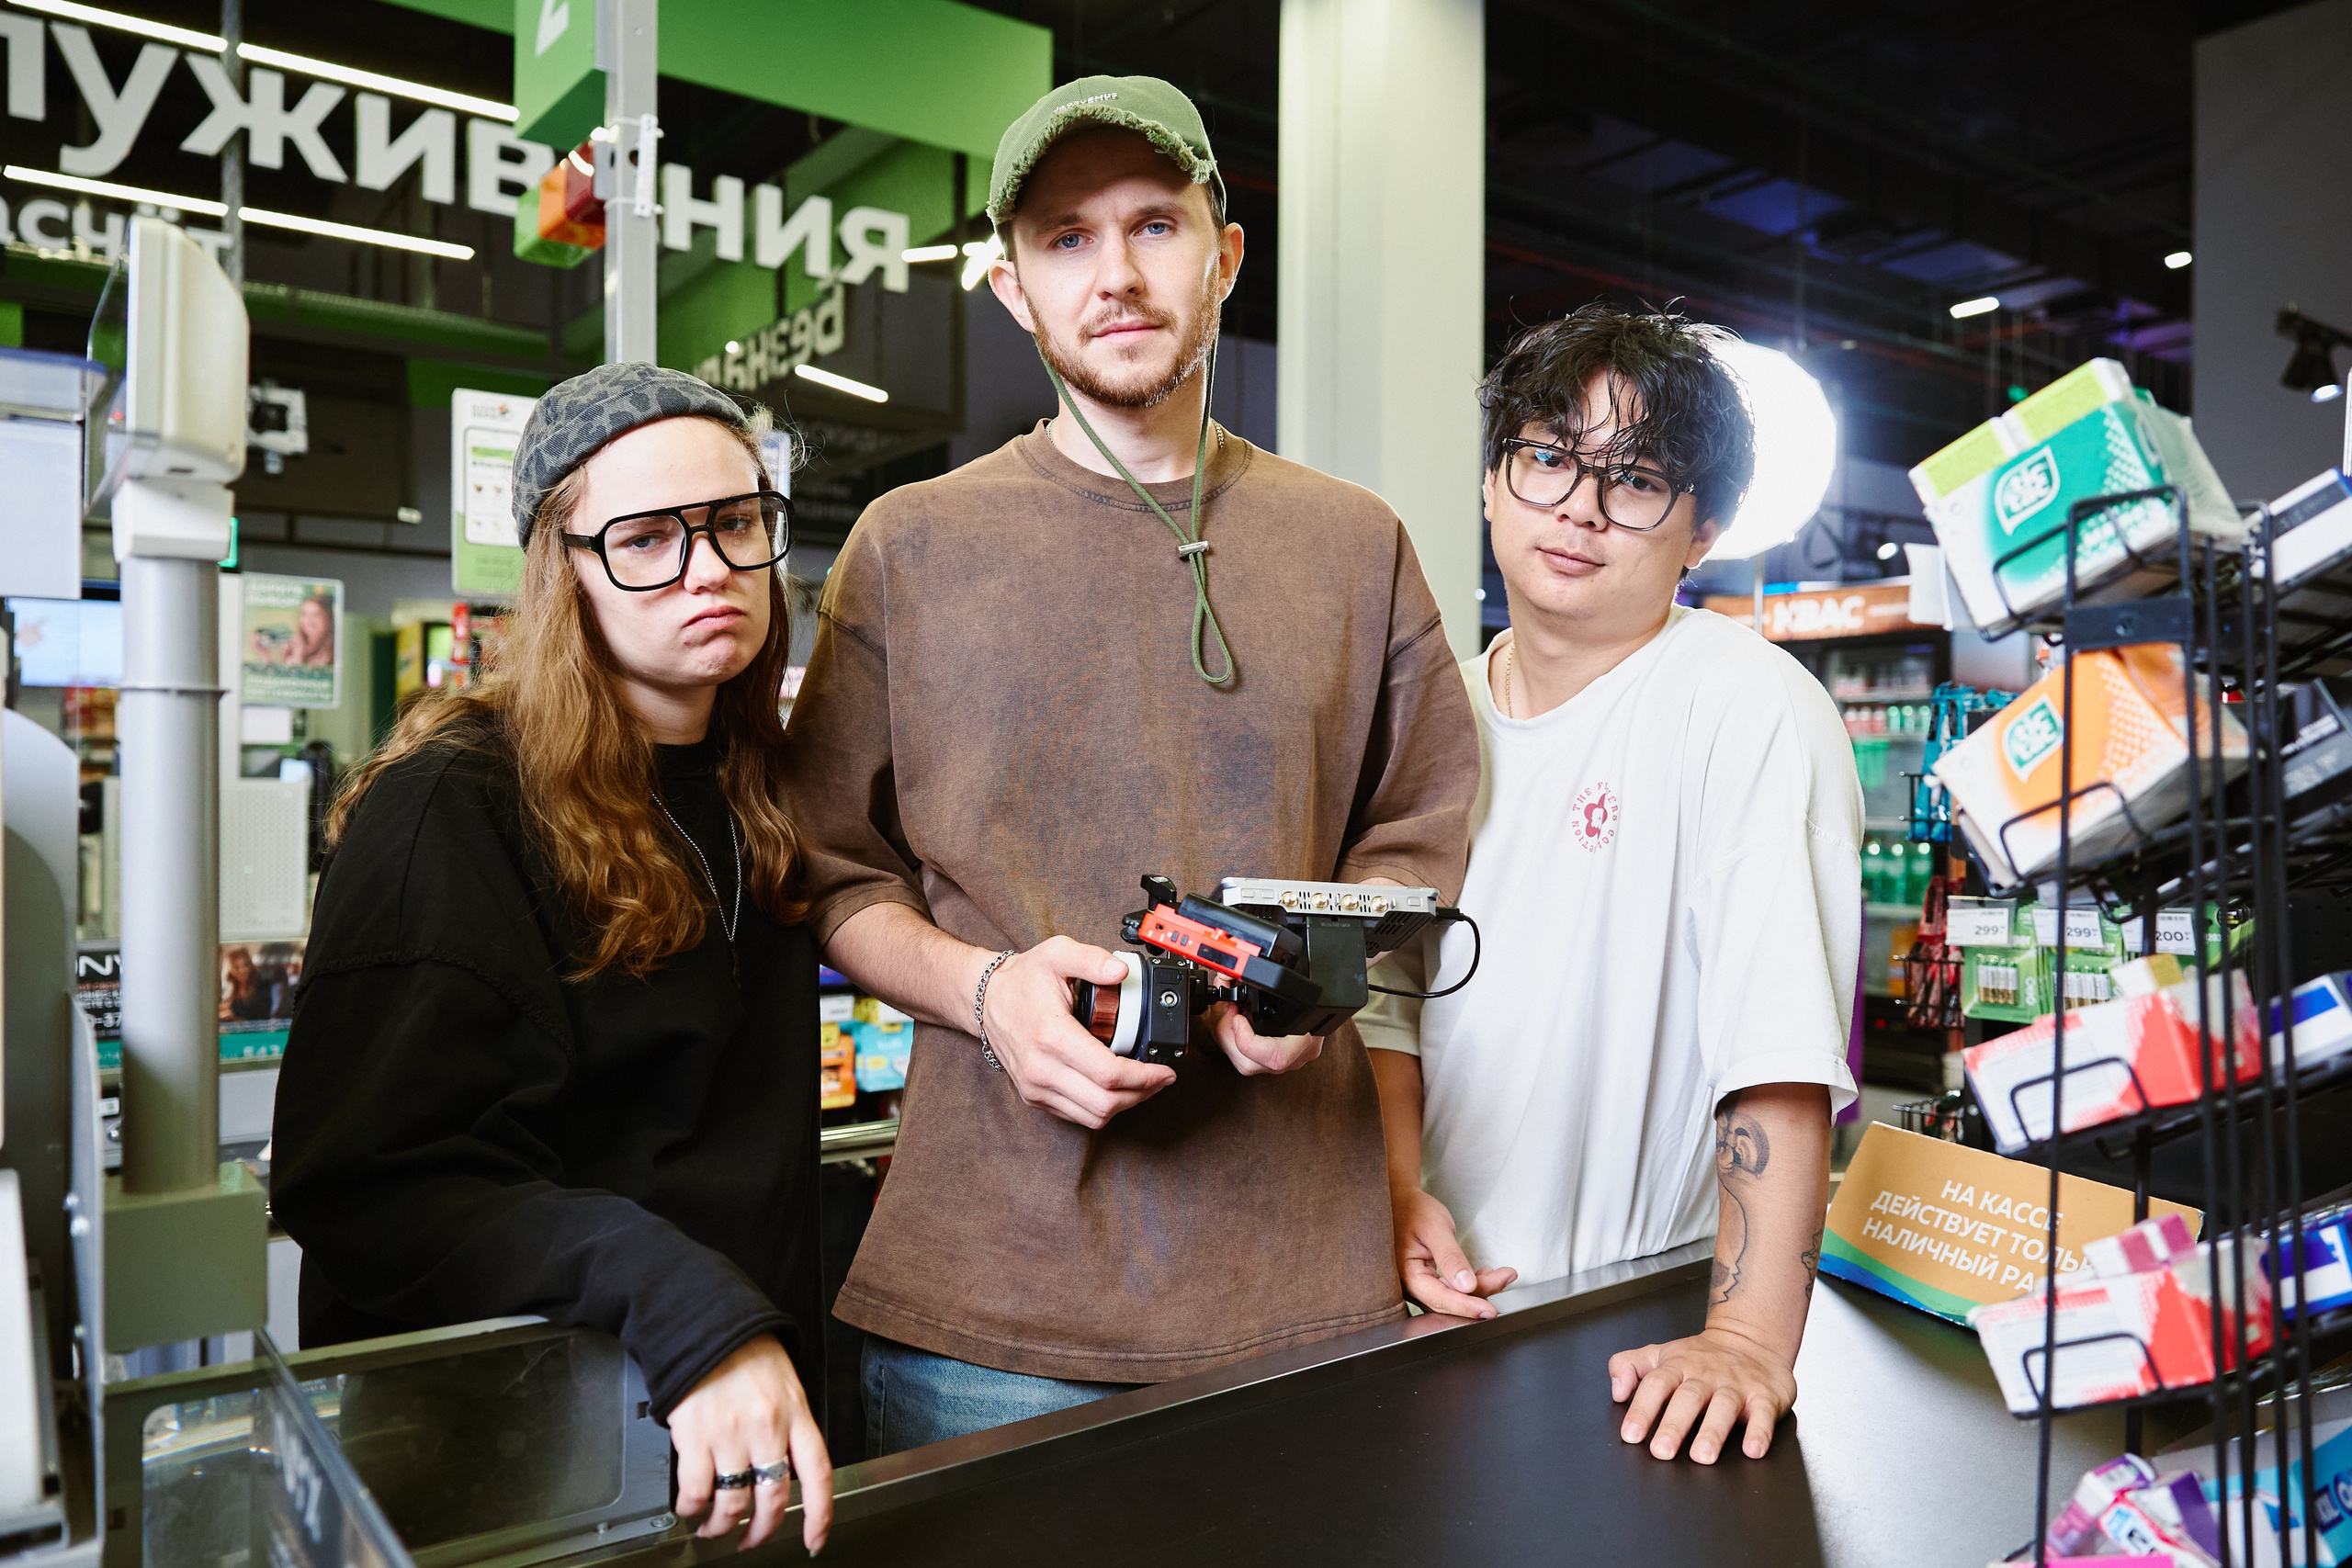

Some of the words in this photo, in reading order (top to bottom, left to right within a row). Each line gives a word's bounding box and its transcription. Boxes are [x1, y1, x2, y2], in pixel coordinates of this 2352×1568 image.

[1773, 595, 1866, 634] КВАС
[1940, 1179, 1974, 1208] НА
[1870, 1190, 2007, 1247] ДЕЙСТВУЕТ
[1862, 1217, 2000, 1280] НАЛИЧНЫЙ
